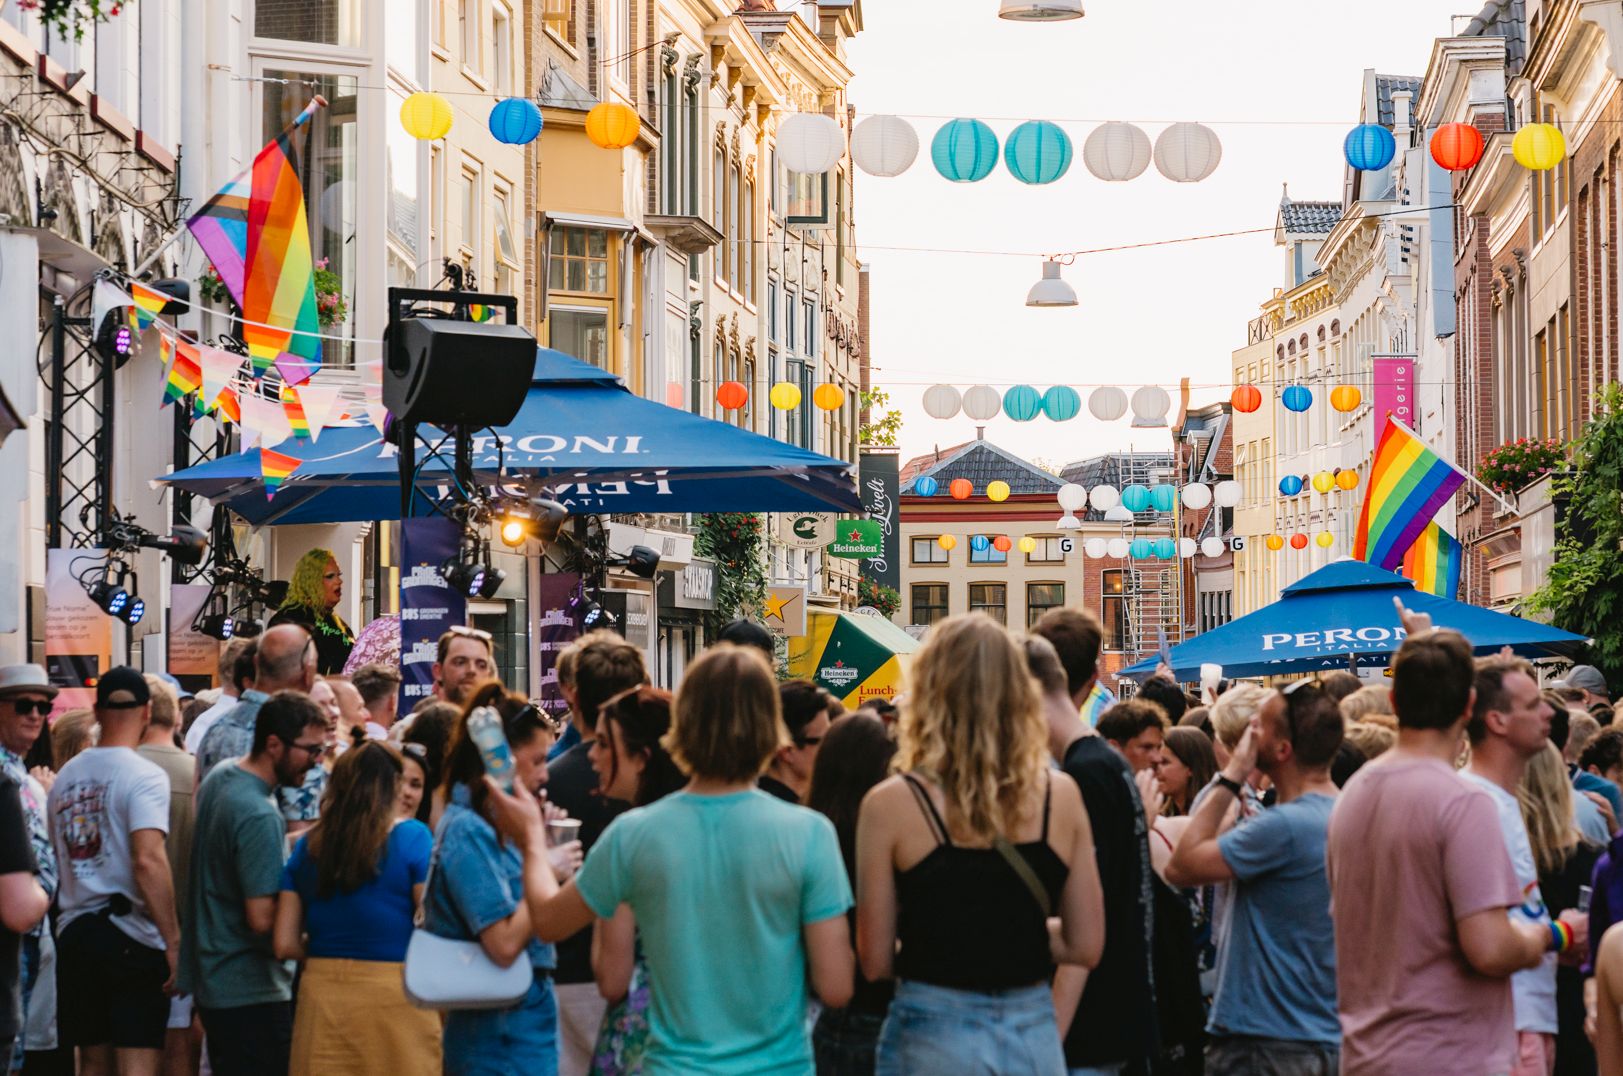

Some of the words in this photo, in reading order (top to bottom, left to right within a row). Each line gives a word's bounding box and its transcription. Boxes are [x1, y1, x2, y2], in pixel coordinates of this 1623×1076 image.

[1394, 366, 1409, 421] gerie
[833, 544, 877, 553] Heineken
[1061, 539, 1072, 552] G
[1232, 538, 1243, 551] G
[1262, 625, 1440, 651] PERON
[1316, 641, 1388, 652] ITALIA
